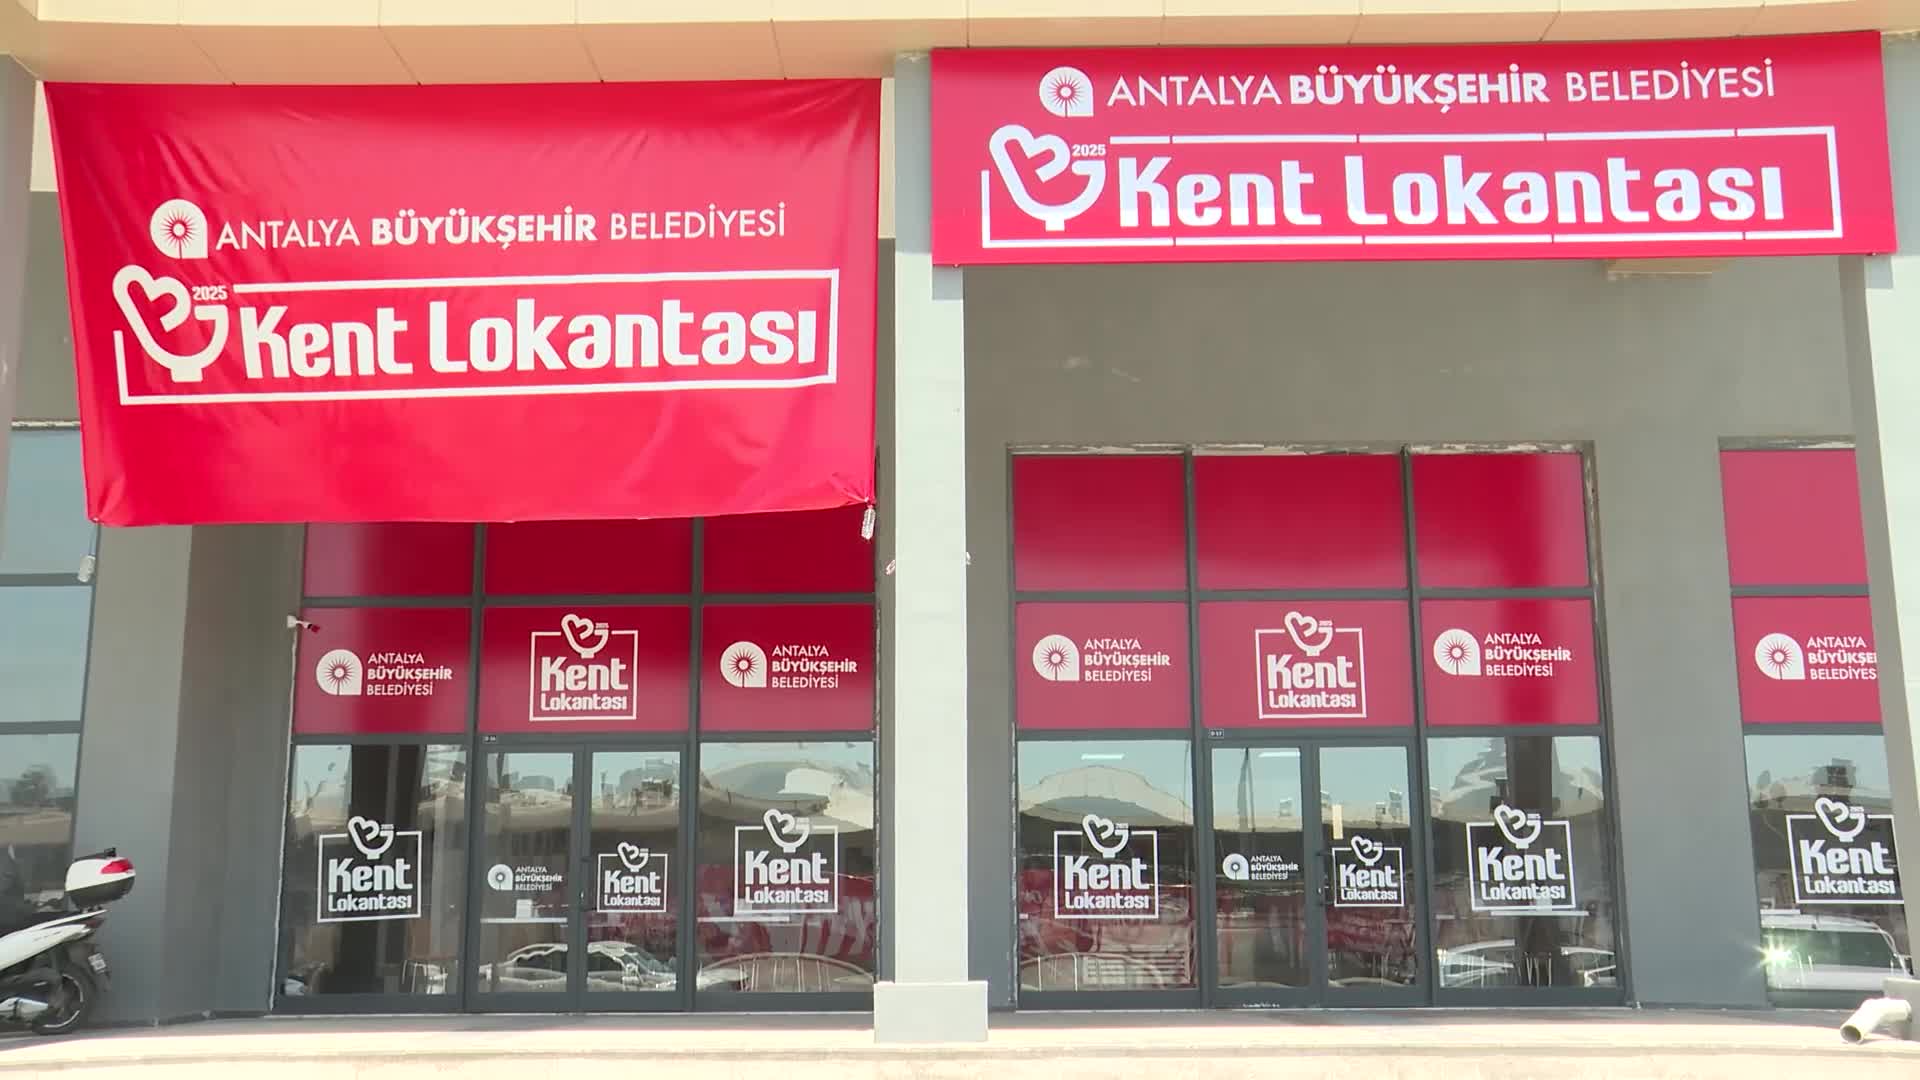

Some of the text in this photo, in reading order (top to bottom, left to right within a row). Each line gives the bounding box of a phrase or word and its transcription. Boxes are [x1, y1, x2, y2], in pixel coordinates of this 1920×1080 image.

[1107, 57, 1775, 114] ANTALYA BÜYÜKŞEHİR BELEDİYESİ
[1072, 144, 1106, 156] 2025
[1118, 154, 1784, 227] Kent Lokantası
[215, 201, 785, 250] ANTALYA BÜYÜKŞEHİR BELEDİYESİ
[192, 285, 228, 301] 2025
[239, 298, 817, 379] Kent Lokantası
[1084, 638, 1142, 649] ANTALYA
[1484, 633, 1542, 644] ANTALYA
[1807, 636, 1866, 648] ANTALYA
[368, 653, 424, 664] ANTALYA
[772, 645, 829, 656] ANTALYA
[1084, 651, 1170, 668] BÜYÜKŞEHİR
[1485, 646, 1572, 663] BÜYÜKŞEHİR
[367, 665, 452, 682] BÜYÜKŞEHİR
[541, 656, 629, 691] Kent
[772, 658, 857, 675] BÜYÜKŞEHİR
[1085, 667, 1152, 682] BELEDİYESİ
[1267, 654, 1357, 689] Kent
[1486, 662, 1553, 676] BELEDİYESİ
[367, 681, 433, 695] BELEDİYESİ
[772, 674, 839, 688] BELEDİYESİ
[541, 692, 627, 710] Lokantası
[1268, 690, 1356, 708] Lokantası
[1478, 846, 1565, 881] Kent
[1800, 840, 1894, 874] Kent
[328, 858, 413, 893] Kent
[745, 850, 829, 885] Kent
[1065, 855, 1150, 890] Kent
[1340, 864, 1398, 888] Kent
[604, 870, 661, 893] Kent
[1804, 876, 1896, 894] Lokantası
[604, 894, 660, 906] Lokantası
[745, 886, 829, 904] Lokantası
[1065, 891, 1149, 909] Lokantası
[1341, 888, 1397, 900] Lokantası
[1481, 882, 1566, 900] Lokantası
[328, 893, 412, 912] Lokantası
